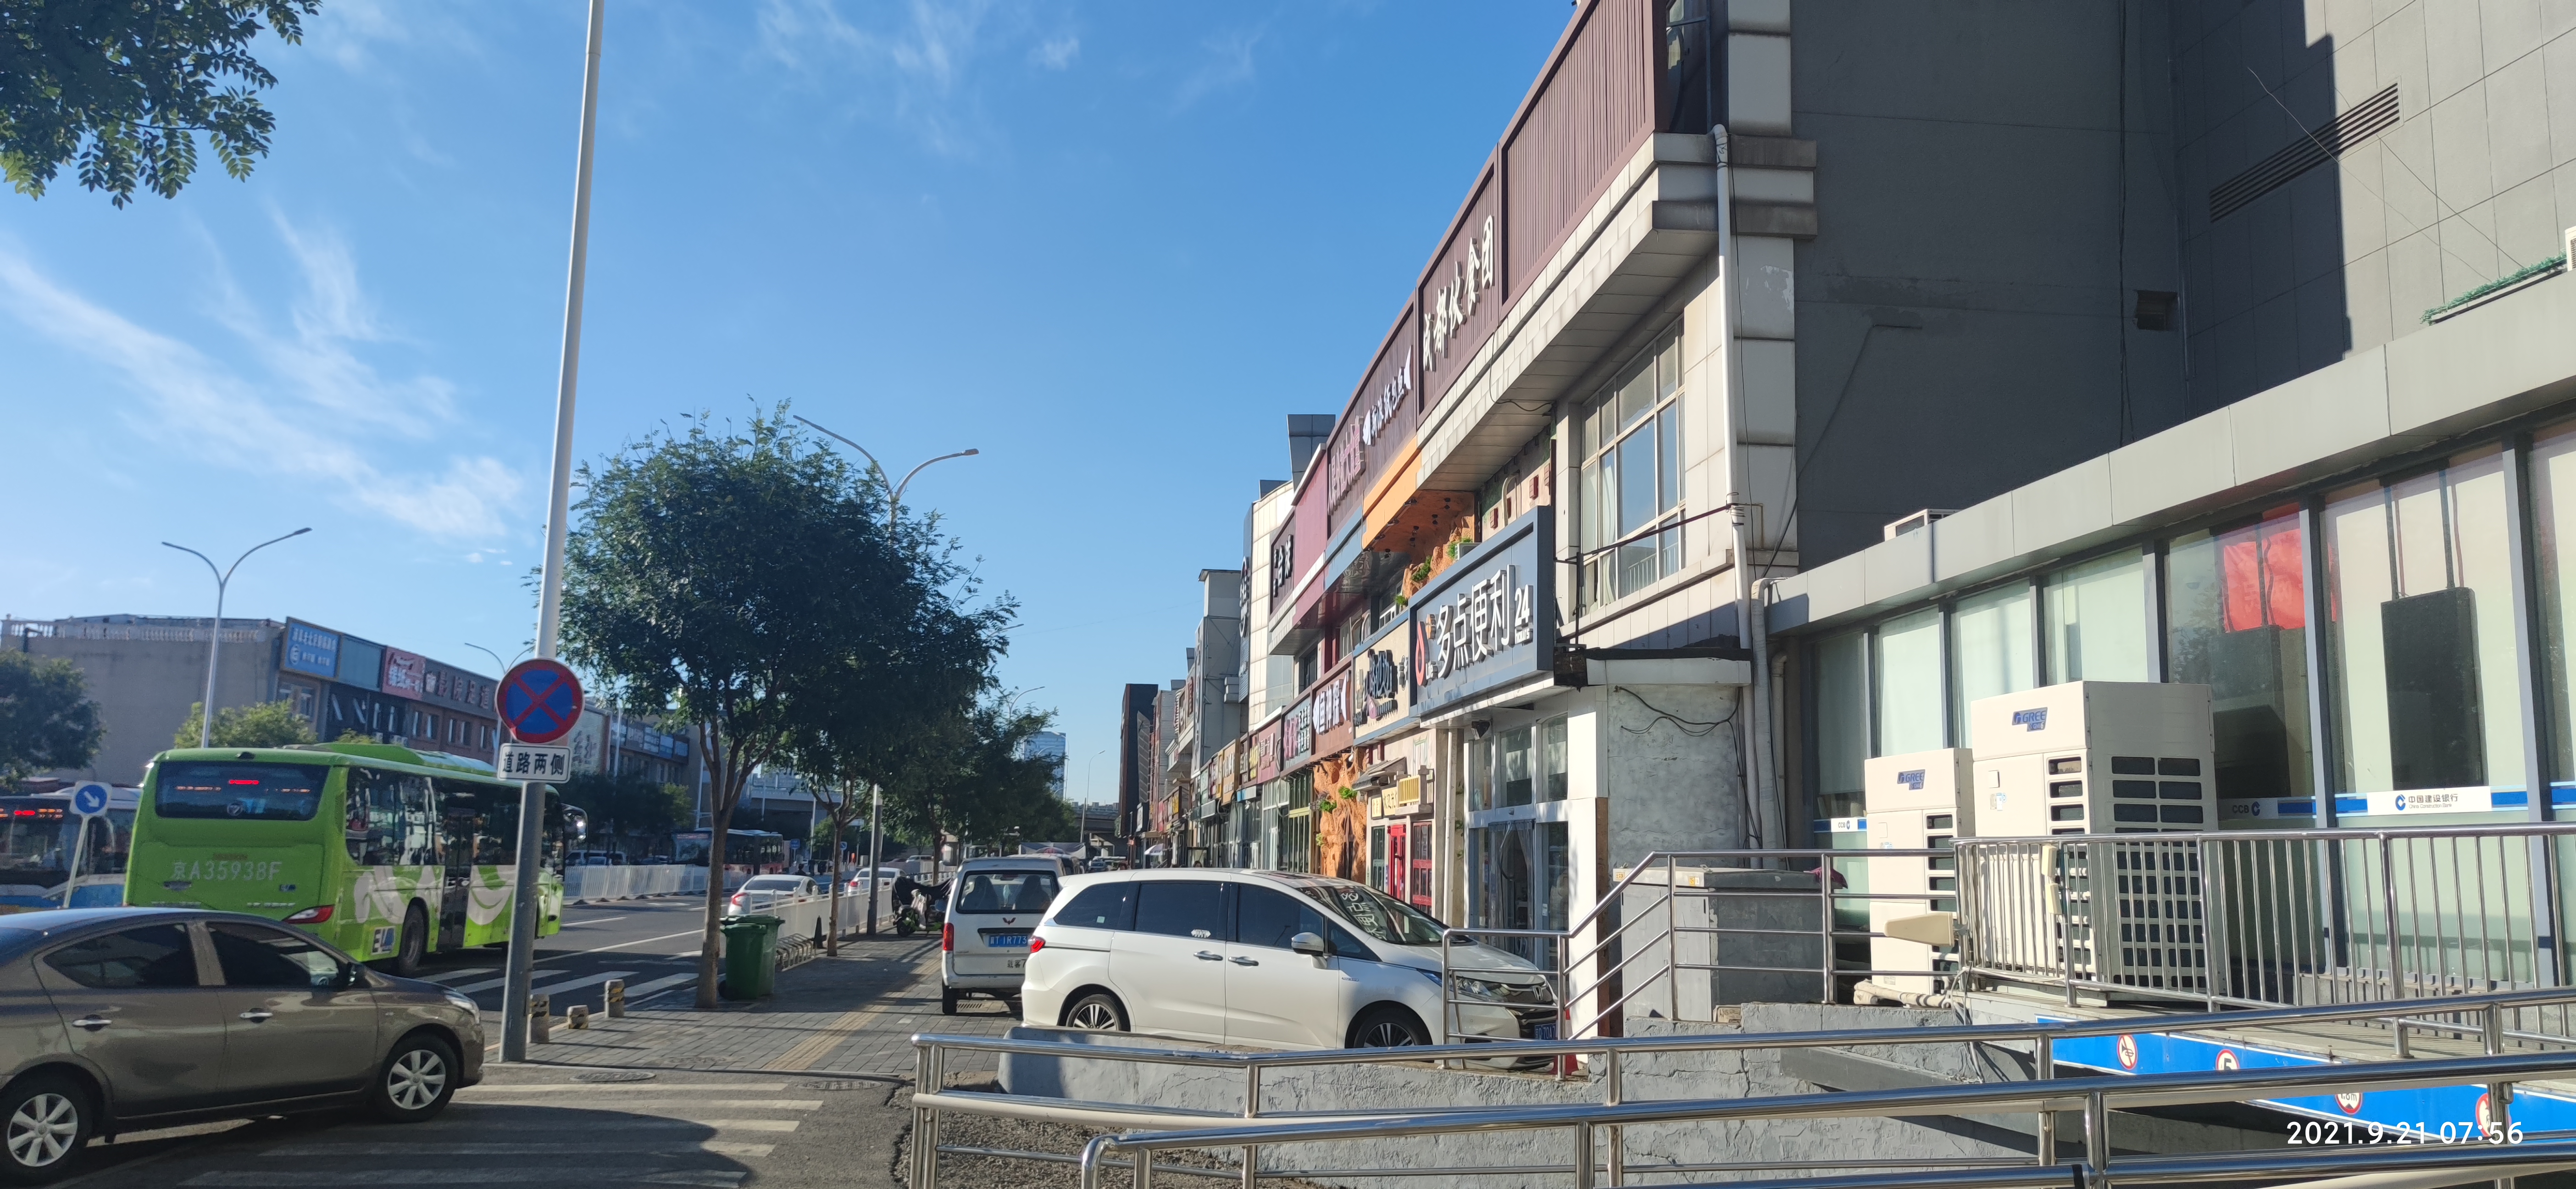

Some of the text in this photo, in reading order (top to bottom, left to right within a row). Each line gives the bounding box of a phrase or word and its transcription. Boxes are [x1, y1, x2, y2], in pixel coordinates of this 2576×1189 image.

[1423, 215, 1493, 371] 成都伙食团
[1327, 415, 1361, 514] 人民公社大食堂
[1515, 584, 1530, 627] 24
[1437, 564, 1510, 678] 多点便利
[1515, 628, 1530, 645] hours
[2022, 710, 2046, 722] GREE
[502, 750, 566, 776] 道路两侧
[1905, 772, 1924, 782] GREE
[2408, 794, 2458, 803] 中国建设银行
[2232, 805, 2249, 813] CCB
[172, 861, 282, 881] 京A35938F
